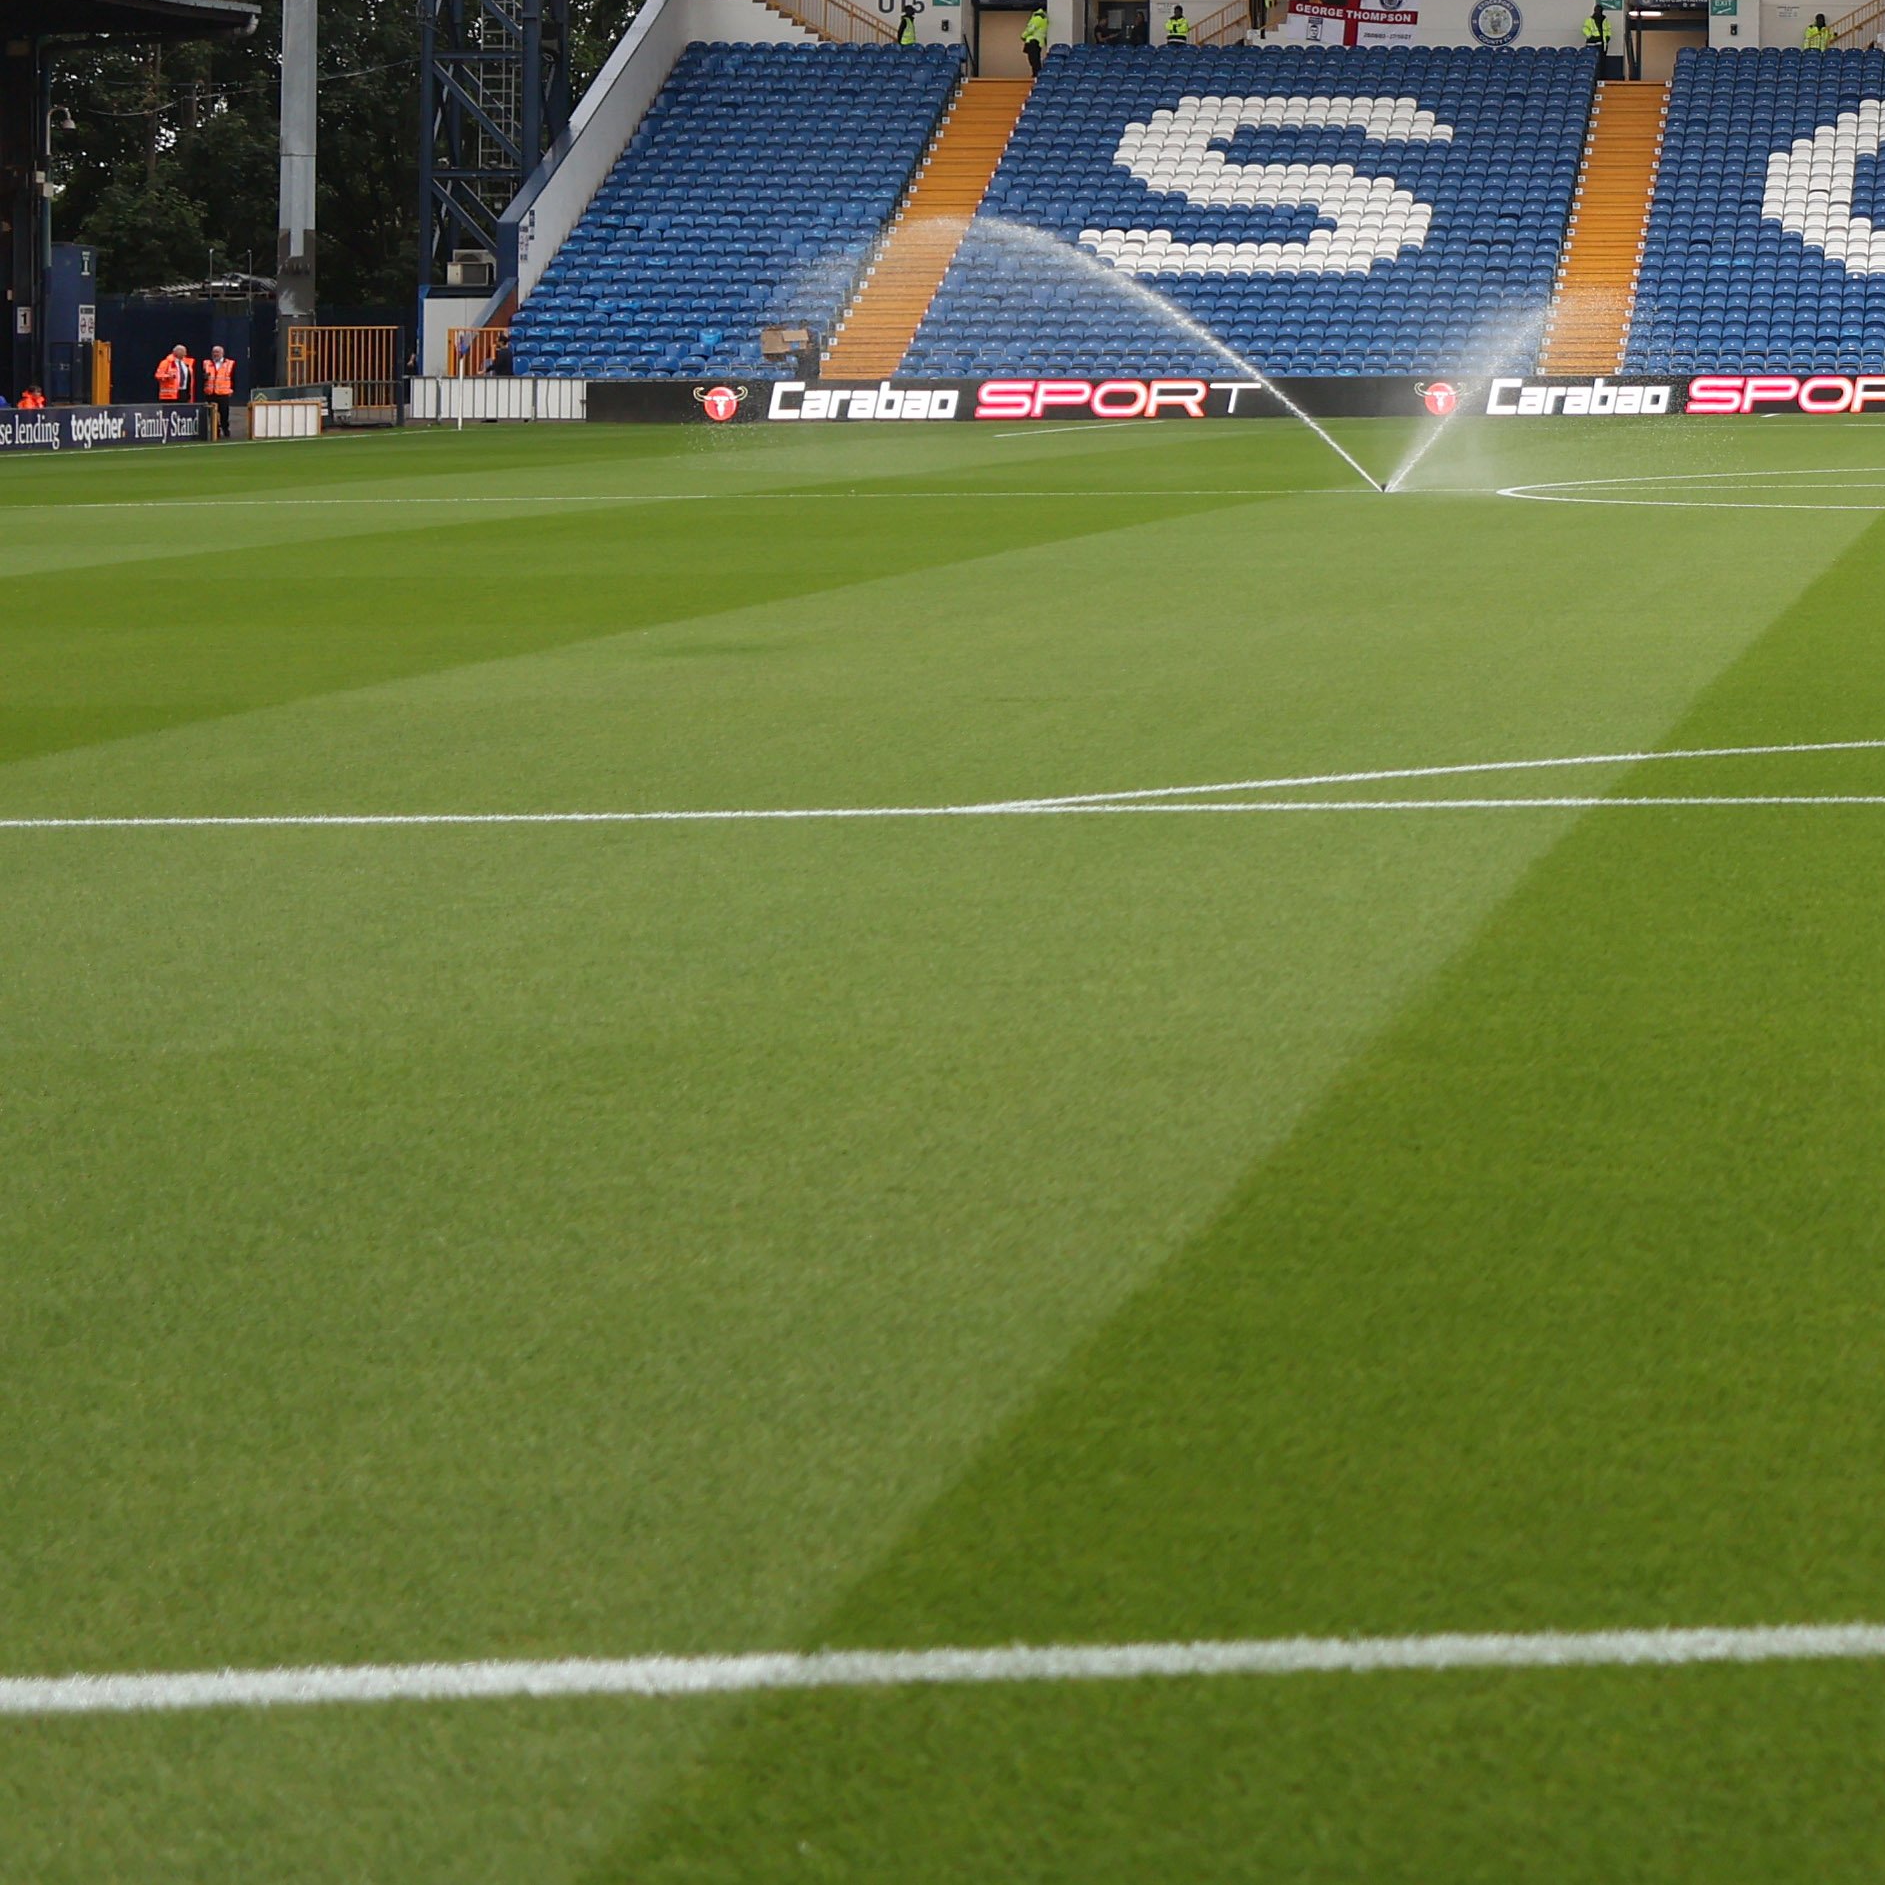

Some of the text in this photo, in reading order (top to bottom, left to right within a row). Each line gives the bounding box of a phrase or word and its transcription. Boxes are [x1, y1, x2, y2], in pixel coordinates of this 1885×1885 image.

[1295, 3, 1412, 24] GEORGE THOMPSON
[1714, 0, 1732, 7] EXIT
[1078, 95, 1453, 275] S
[768, 380, 1262, 421] Carabao SPORT
[1485, 378, 1671, 415] Carabao
[15, 414, 61, 451] lending
[134, 409, 170, 445] Family
[170, 408, 200, 438] Stand
